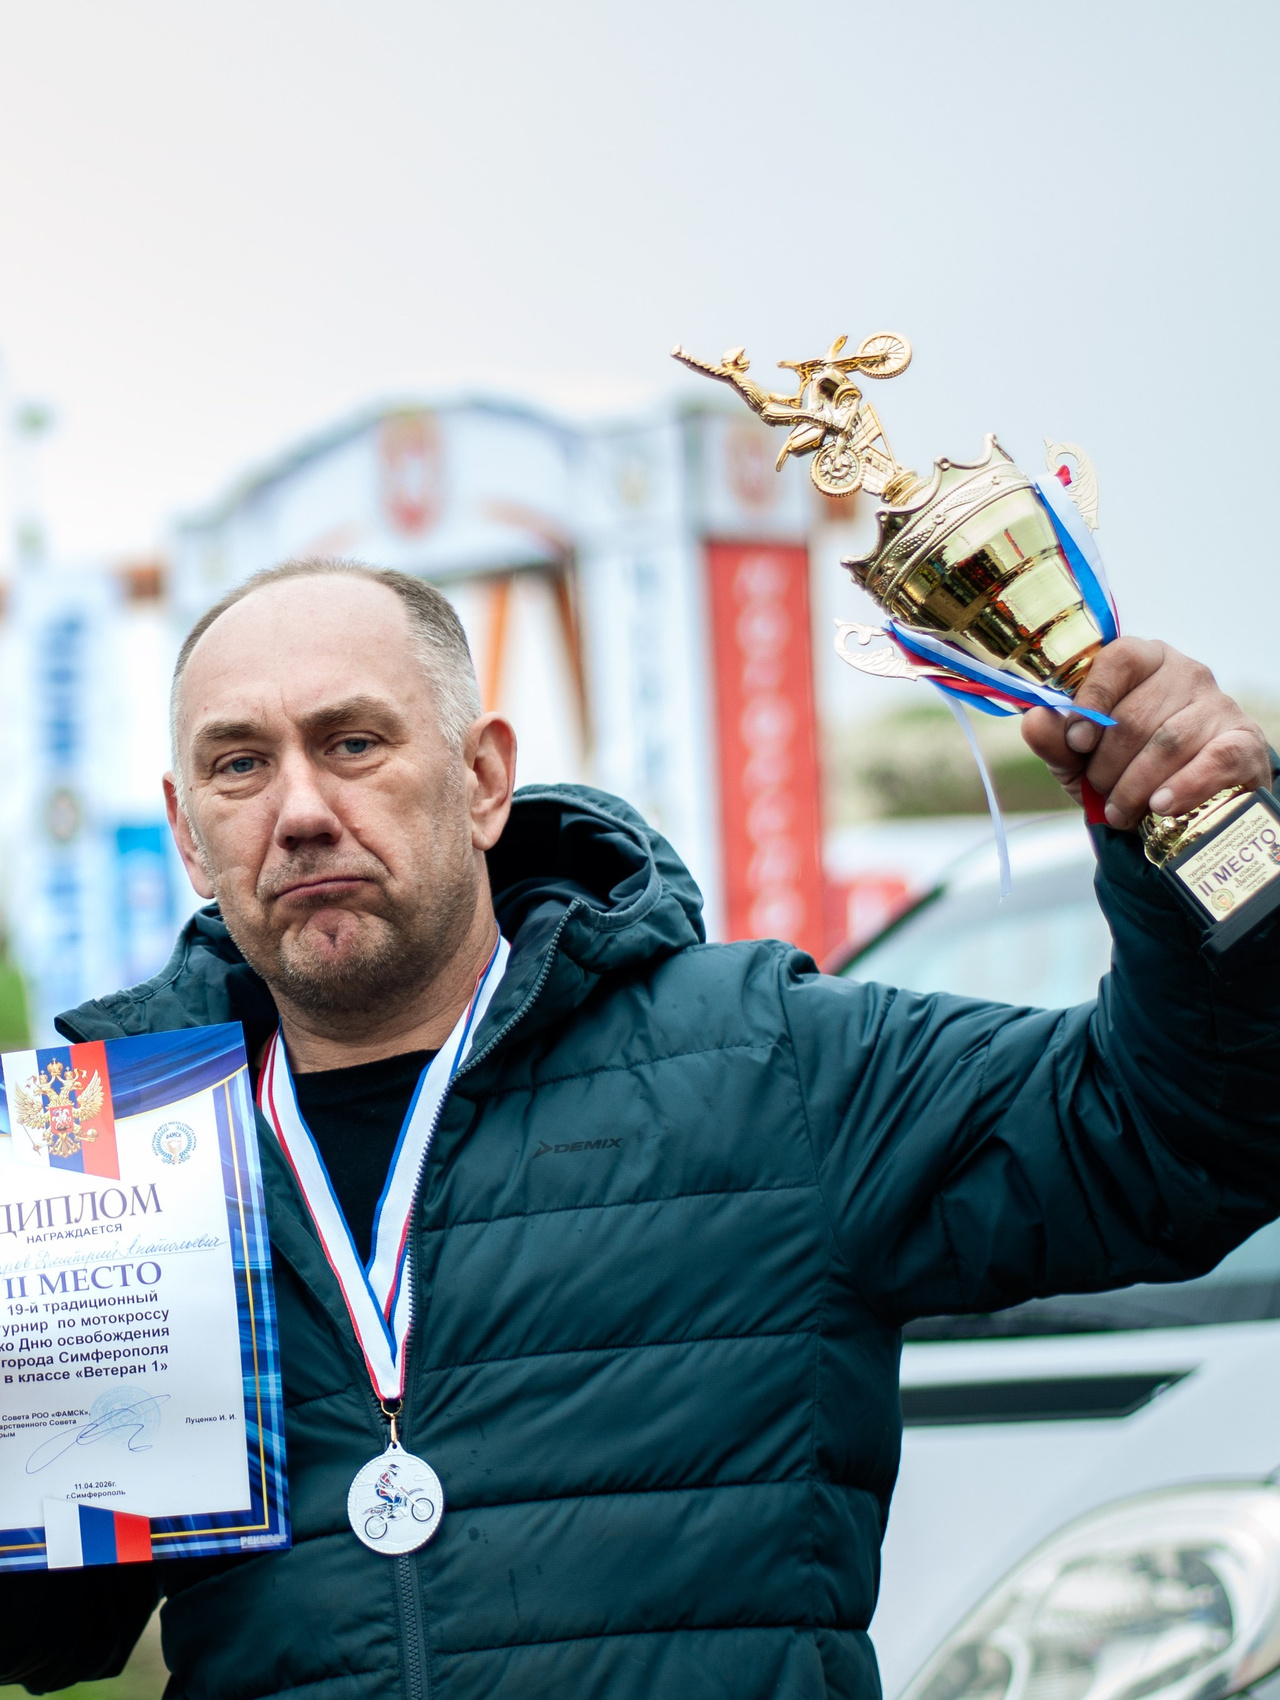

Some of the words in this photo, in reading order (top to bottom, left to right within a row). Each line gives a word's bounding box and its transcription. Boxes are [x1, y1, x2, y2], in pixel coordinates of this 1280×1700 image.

[1212, 828, 1277, 885] МЕСТО
[553, 1138, 623, 1154] DEMIX
[26, 1223, 123, 1244] НАГРАЖДАЕТСЯ
[3, 1275, 30, 1300] II
[38, 1261, 163, 1297] МЕСТО
[7, 1302, 39, 1316] 19-й
[43, 1291, 158, 1314] традиционный
[57, 1317, 76, 1329] по
[80, 1308, 170, 1327] мотокроссу
[19, 1334, 53, 1353] Дню
[57, 1326, 170, 1348] освобождения
[0, 1354, 54, 1370] города
[59, 1343, 169, 1365] Симферополя
[4, 1373, 14, 1384] в
[18, 1368, 71, 1384] классе
[75, 1363, 147, 1379] «Ветеран
[151, 1360, 168, 1373] 1»
[1, 1414, 30, 1422] Совета
[66, 1490, 126, 1500] г.Симферополь
[74, 1480, 117, 1490] 11.04.2026г.
